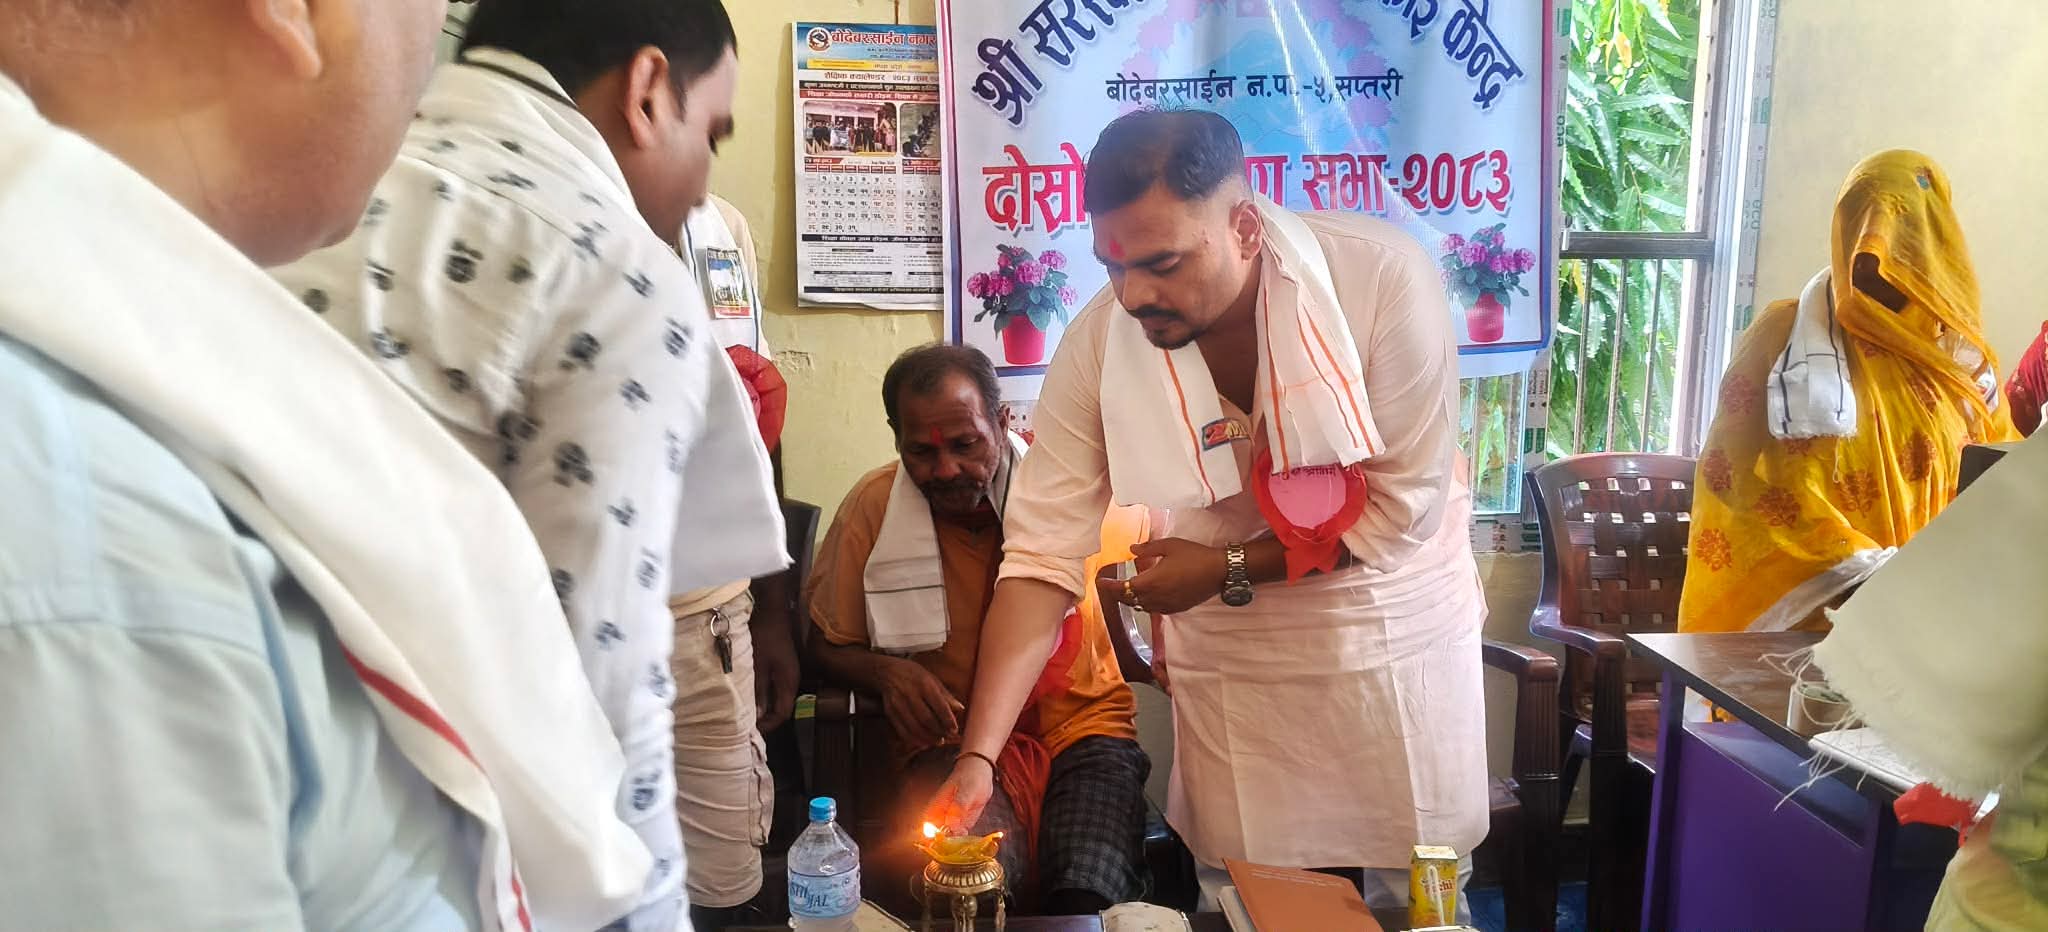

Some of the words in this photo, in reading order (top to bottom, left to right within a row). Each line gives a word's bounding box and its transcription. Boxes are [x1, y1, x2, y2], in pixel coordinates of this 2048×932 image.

[972, 38, 1043, 126] श्री
[1443, 0, 1524, 110] केन्द्र
[1104, 69, 1237, 104] बोदेबरसाईन
